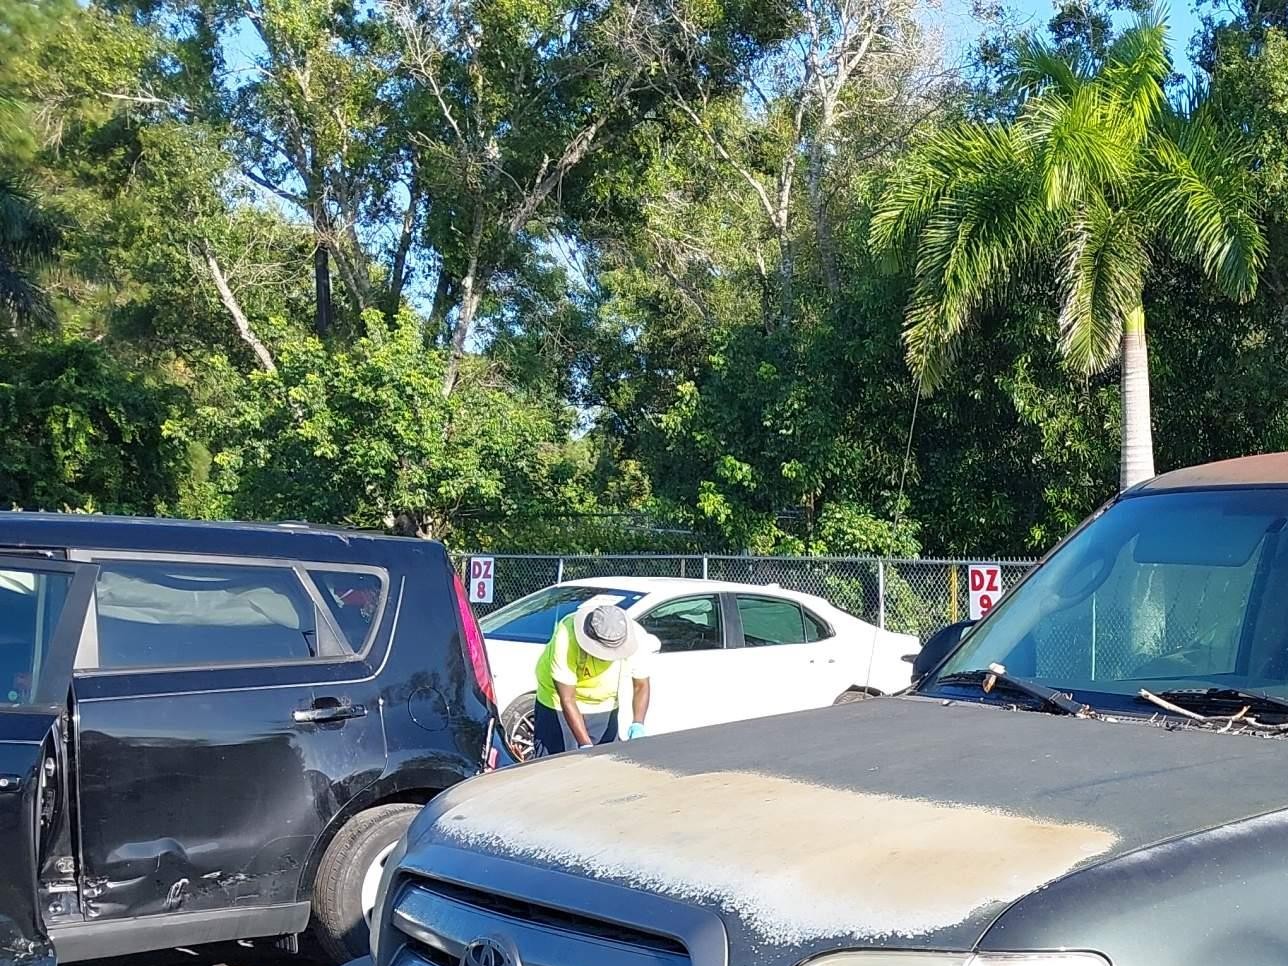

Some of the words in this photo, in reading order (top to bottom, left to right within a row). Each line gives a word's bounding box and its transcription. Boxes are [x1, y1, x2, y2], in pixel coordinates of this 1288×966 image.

[472, 561, 492, 579] DZ
[970, 569, 999, 591] DZ
[477, 581, 486, 599] 8
[979, 594, 992, 617] 9
